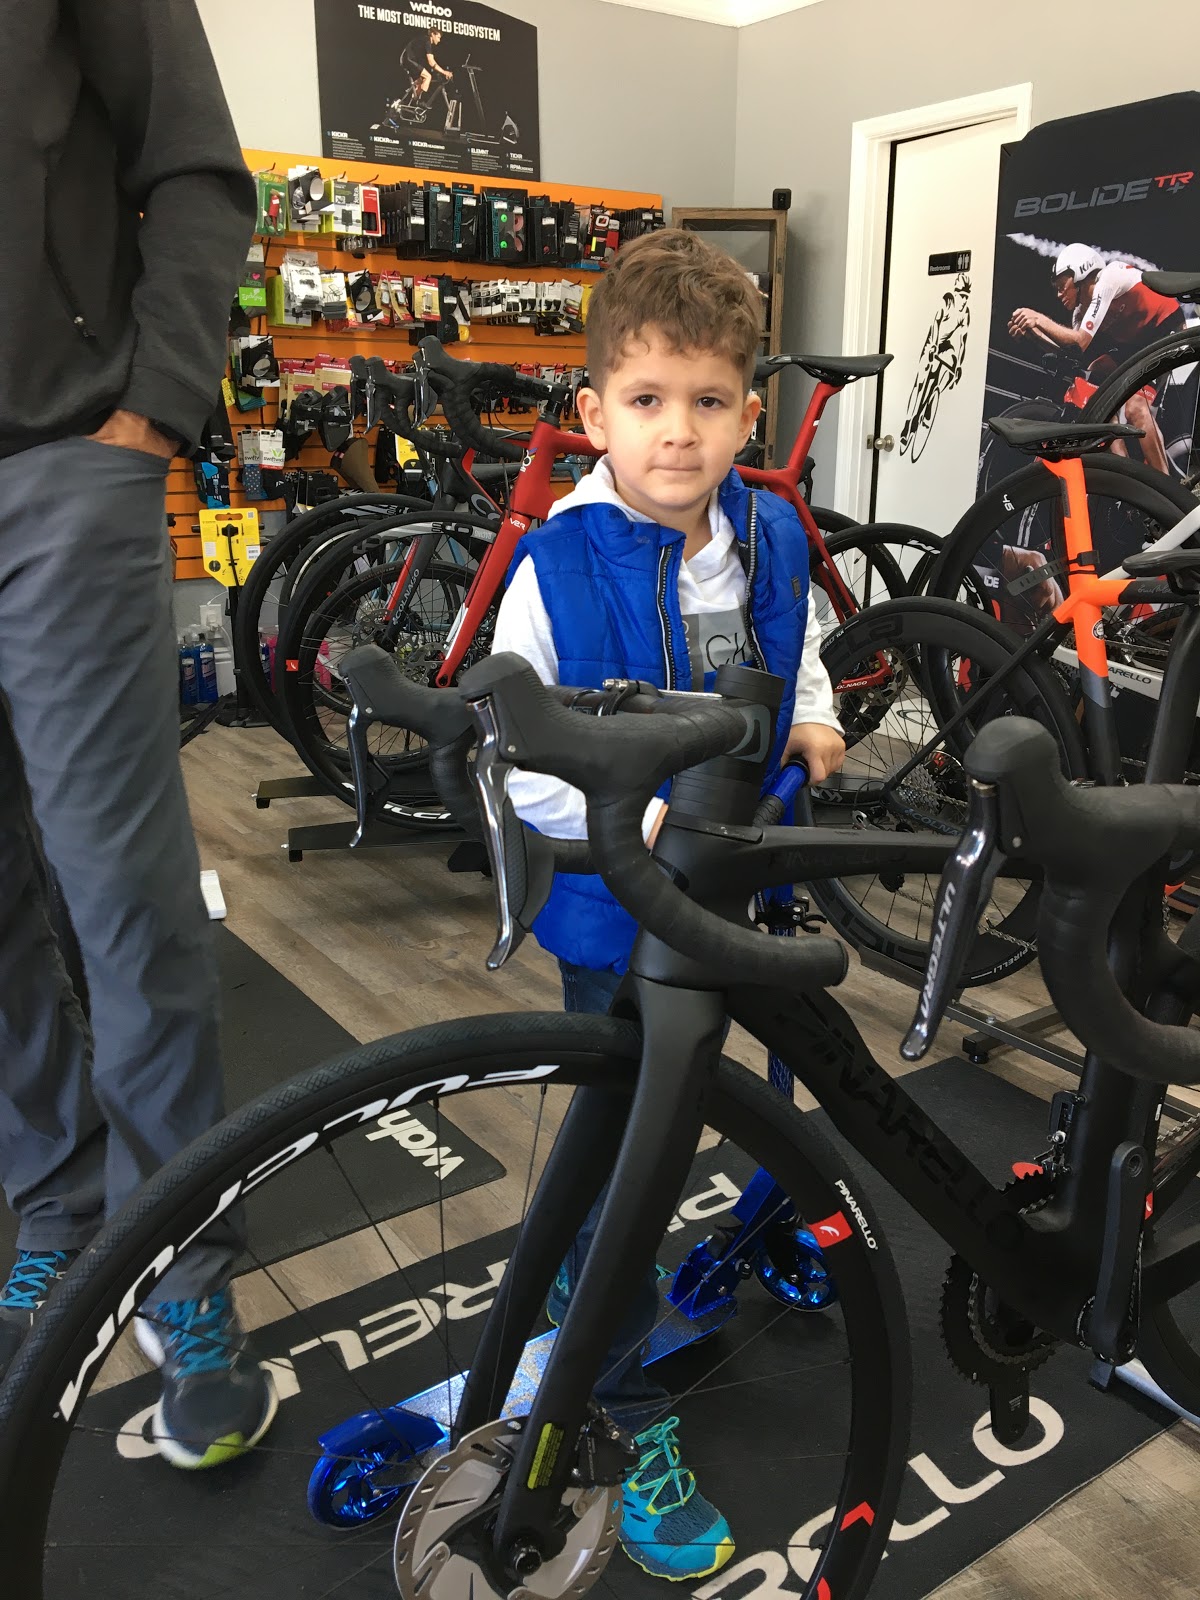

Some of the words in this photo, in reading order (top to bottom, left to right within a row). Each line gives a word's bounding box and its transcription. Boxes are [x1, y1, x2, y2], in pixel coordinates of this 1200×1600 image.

[409, 1, 452, 17] wahoo
[358, 5, 375, 20] THE
[376, 8, 401, 25] MOST
[403, 12, 452, 33] CONNECTED
[453, 22, 501, 42] ECOSYSTEM
[1014, 178, 1152, 218] BOLIDE
[1154, 171, 1194, 188] TR
[1002, 493, 1015, 512] 45
[1108, 666, 1152, 685] ARELLO
[911, 812, 961, 837] COLNA
[993, 947, 1029, 974] PIRELLI
[366, 1101, 465, 1179] wah
[833, 1179, 878, 1251] PINARELLO
